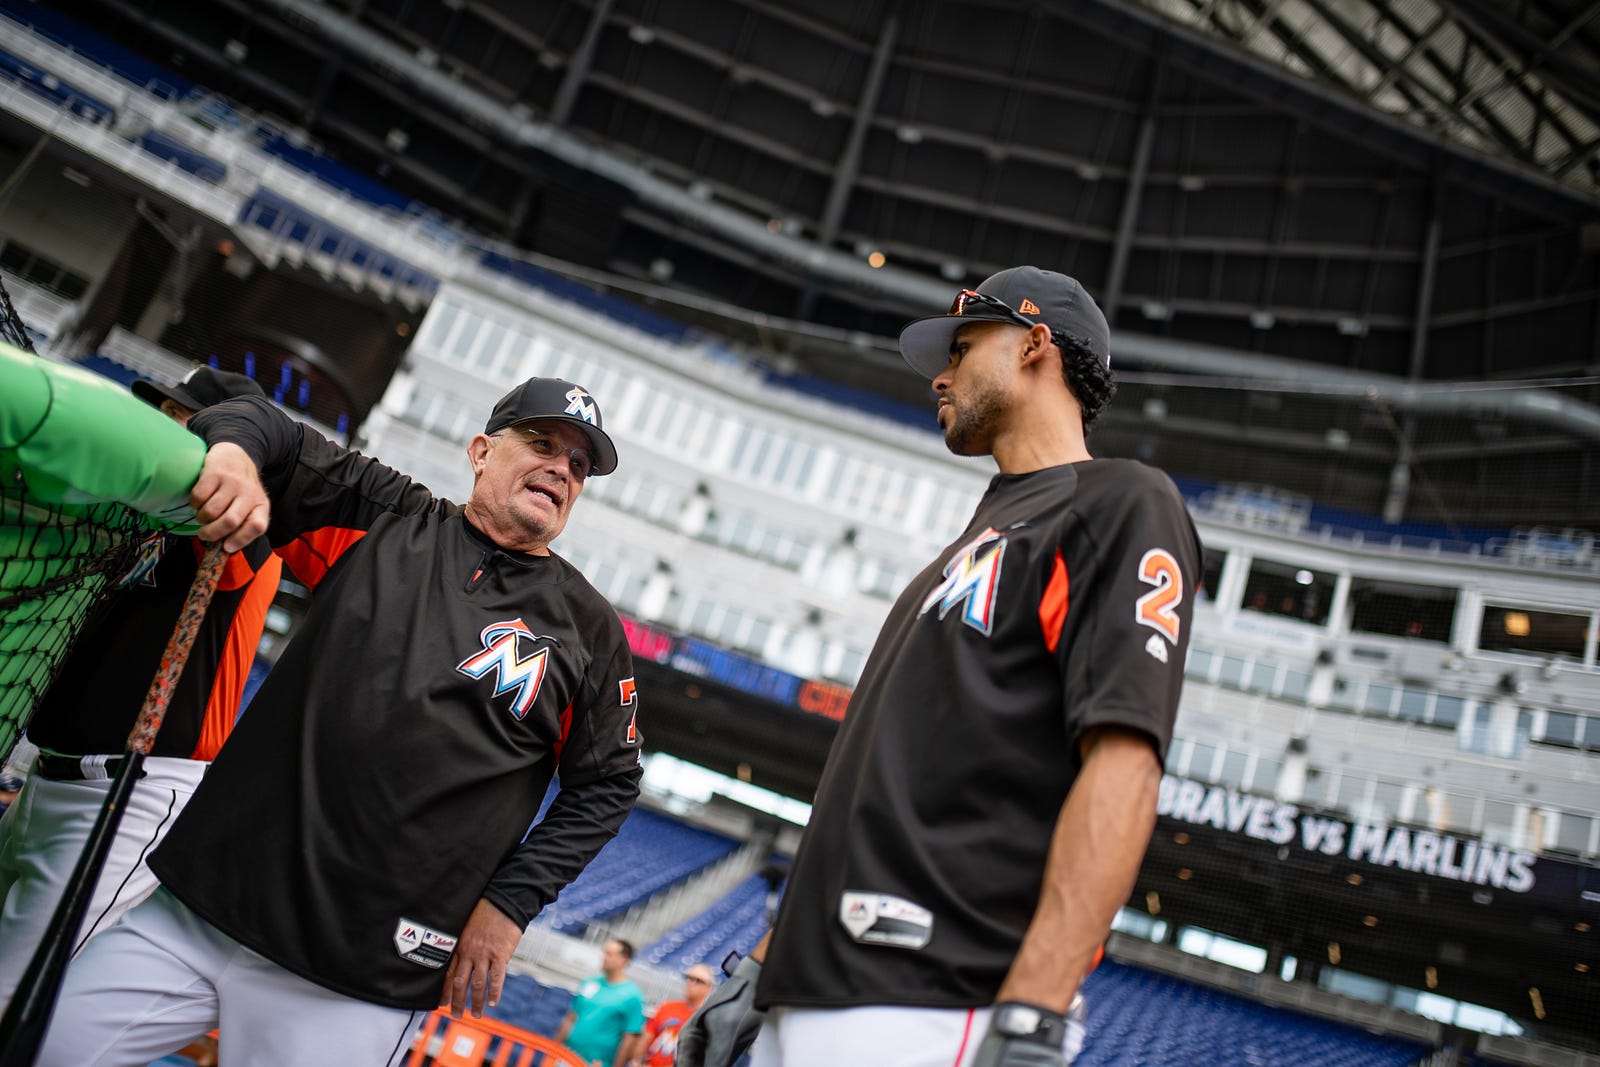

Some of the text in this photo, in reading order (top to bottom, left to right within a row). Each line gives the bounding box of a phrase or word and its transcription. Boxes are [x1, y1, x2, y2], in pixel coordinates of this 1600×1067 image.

[1135, 547, 1184, 648] 2
[455, 617, 550, 721] M
[618, 676, 639, 744] 7
[1156, 773, 1300, 845] BRAVES
[1347, 820, 1538, 894] MARLINS
